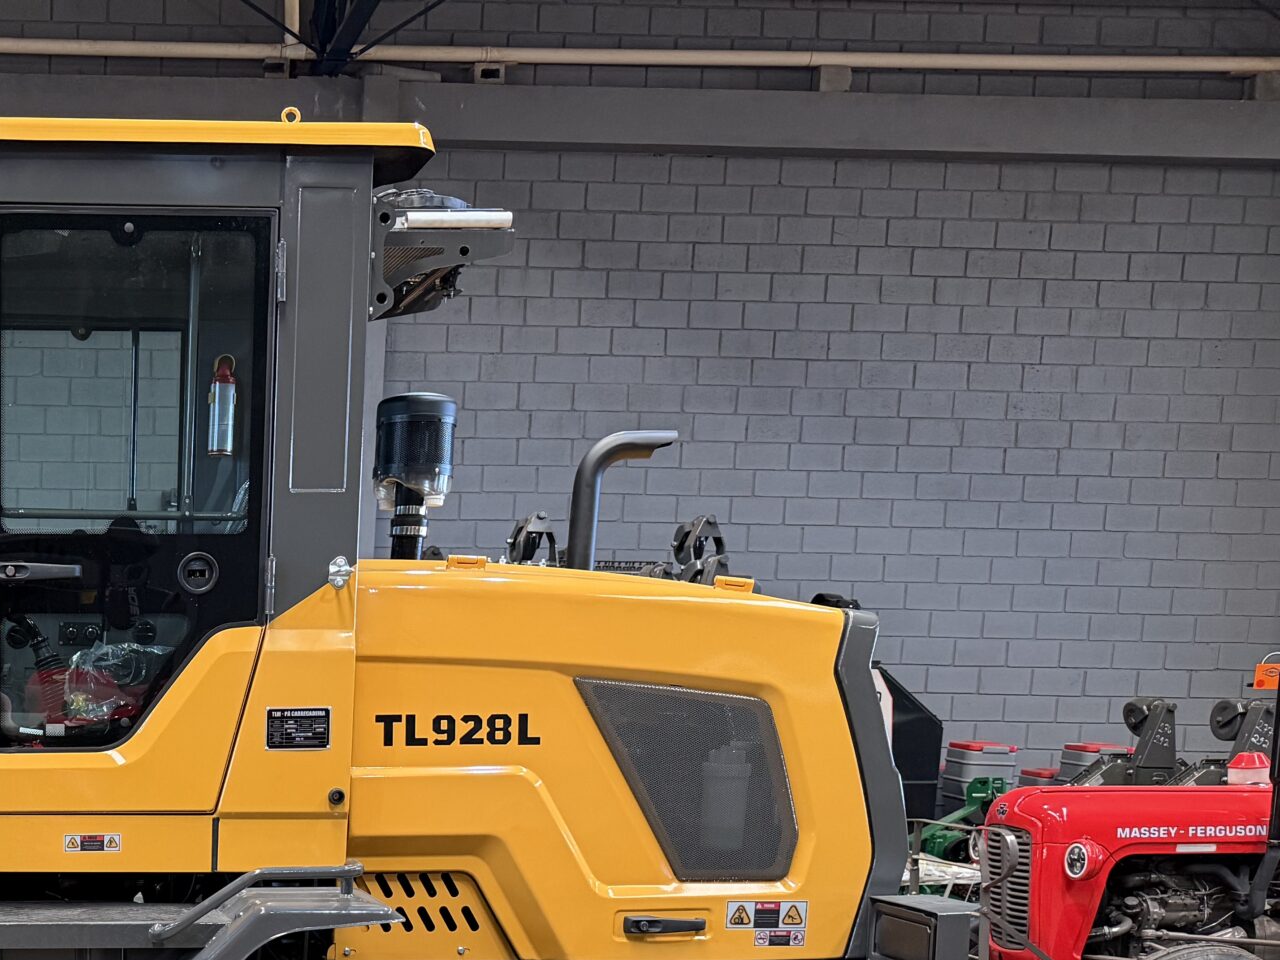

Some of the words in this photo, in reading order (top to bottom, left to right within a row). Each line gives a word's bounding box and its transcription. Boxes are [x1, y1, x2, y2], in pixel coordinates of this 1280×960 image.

[375, 713, 541, 747] TL928L
[1117, 826, 1178, 838] MASSEY
[1188, 825, 1268, 838] FERGUSON
